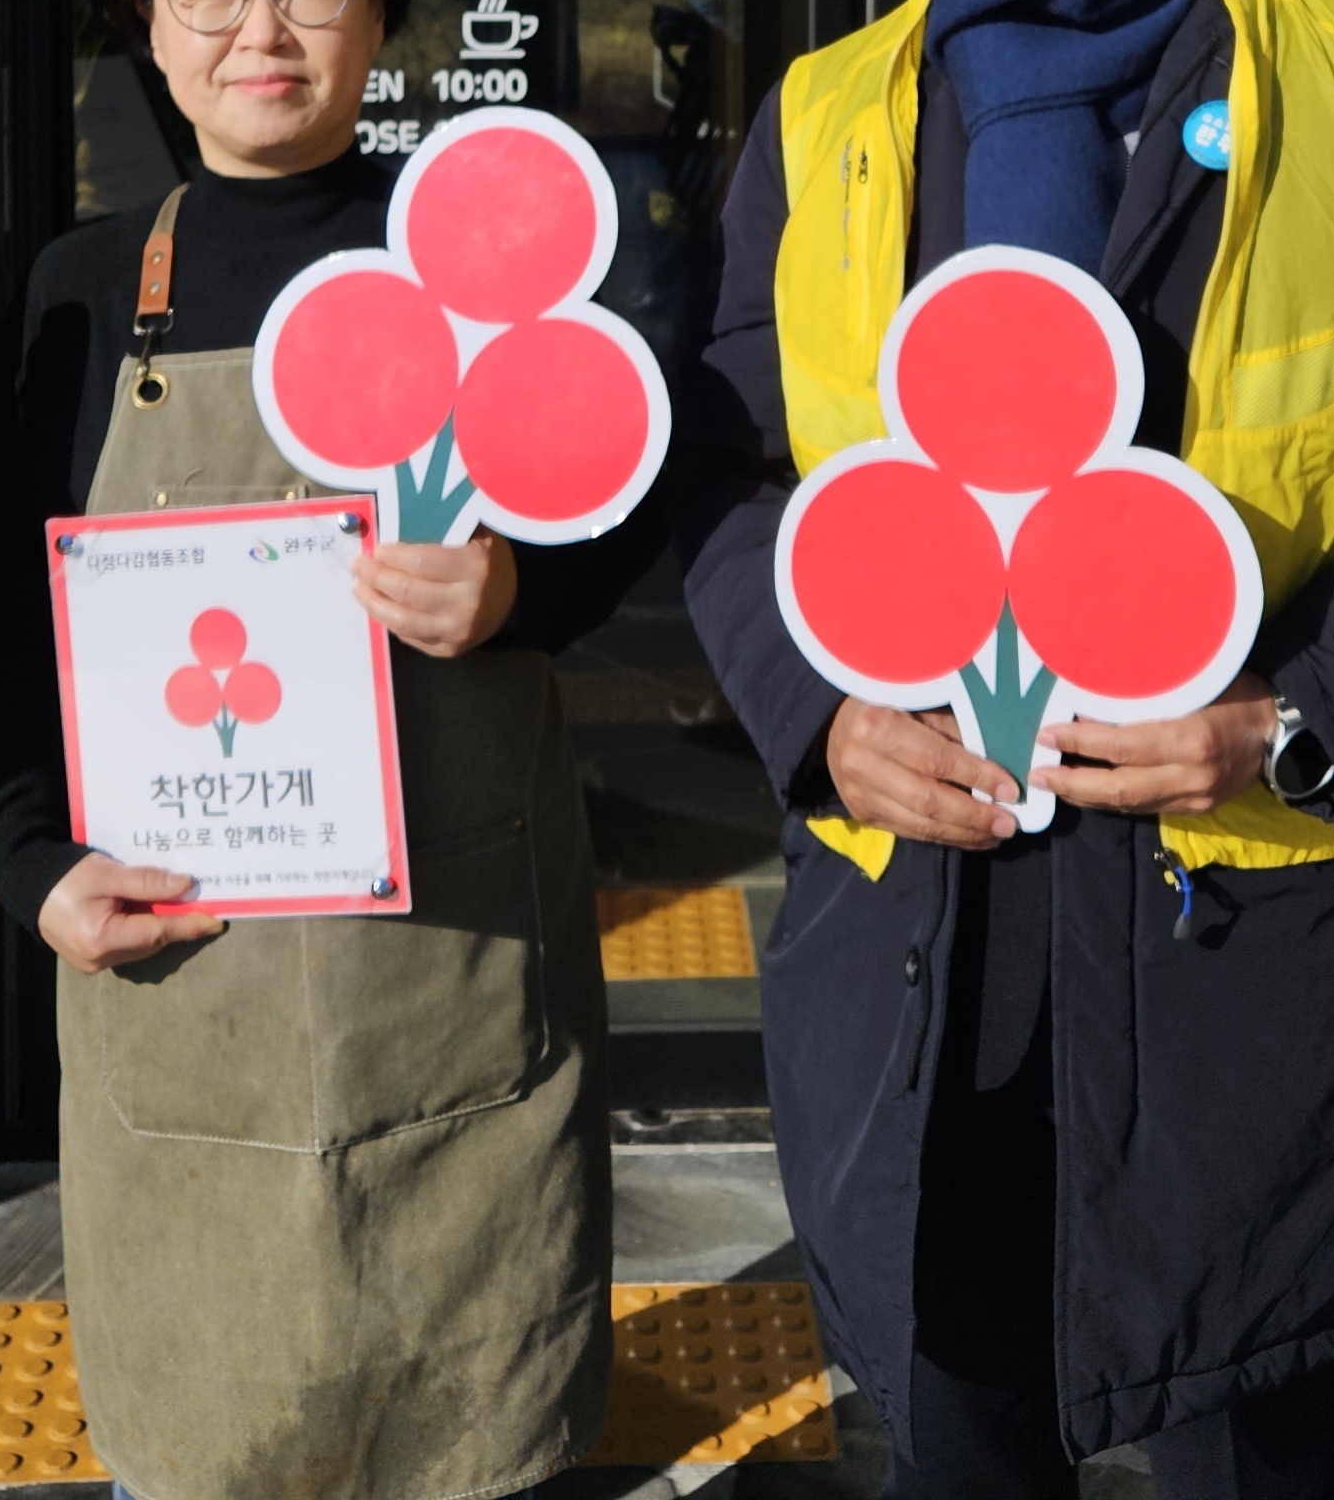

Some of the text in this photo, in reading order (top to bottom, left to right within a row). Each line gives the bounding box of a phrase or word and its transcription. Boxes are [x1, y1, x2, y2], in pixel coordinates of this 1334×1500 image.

[431, 68, 529, 103] 10:00
[87, 546, 205, 571] 다정다감협동조합
[284, 535, 336, 554] 완주군
[150, 768, 315, 819] 착한가게
[133, 822, 338, 852] 나눔으로 함께하는 곳
